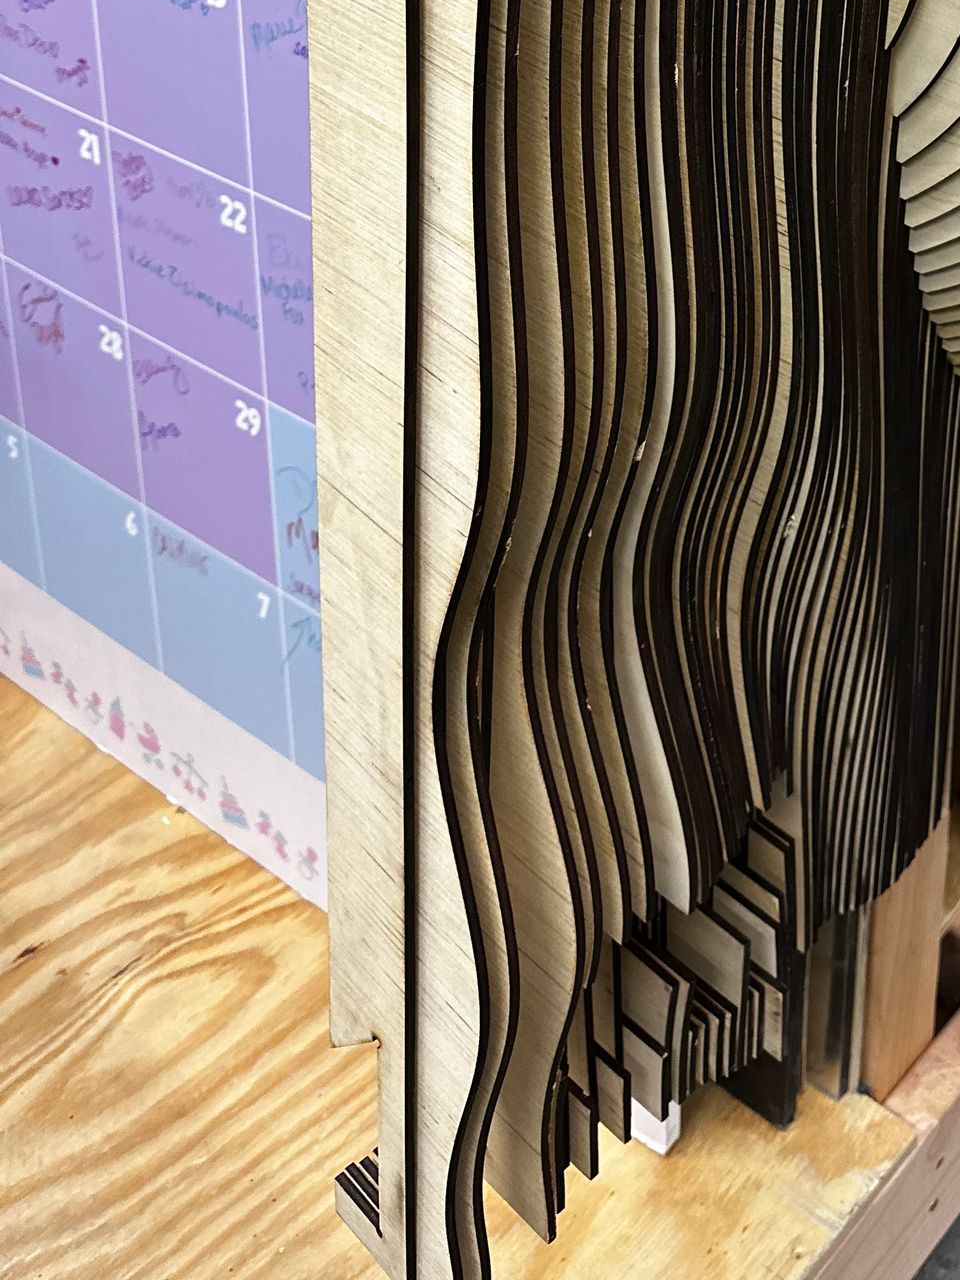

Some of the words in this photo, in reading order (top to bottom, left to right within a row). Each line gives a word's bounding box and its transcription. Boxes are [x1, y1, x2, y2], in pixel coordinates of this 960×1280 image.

[78, 128, 101, 166] 21
[219, 194, 248, 235] 22
[234, 398, 262, 437] 29
[257, 590, 271, 619] 7
